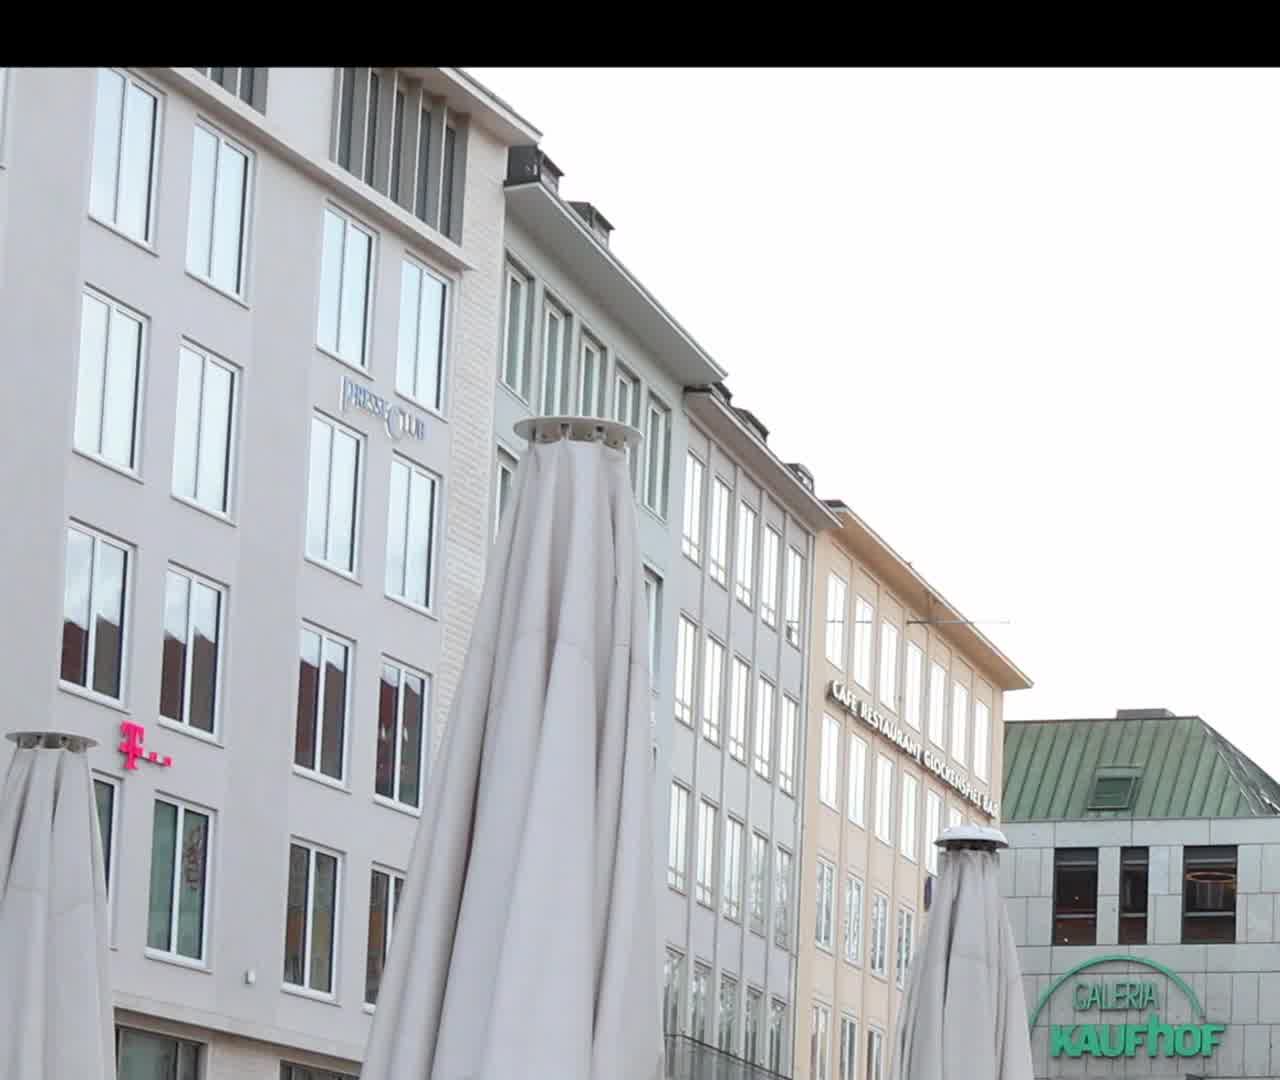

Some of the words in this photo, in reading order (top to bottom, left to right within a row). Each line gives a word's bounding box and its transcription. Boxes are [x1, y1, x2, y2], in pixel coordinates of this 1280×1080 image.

[860, 701, 922, 762] RESTAURANT
[923, 750, 983, 808] GLOCKENSPIEL
[1074, 978, 1161, 1011] GALERIA
